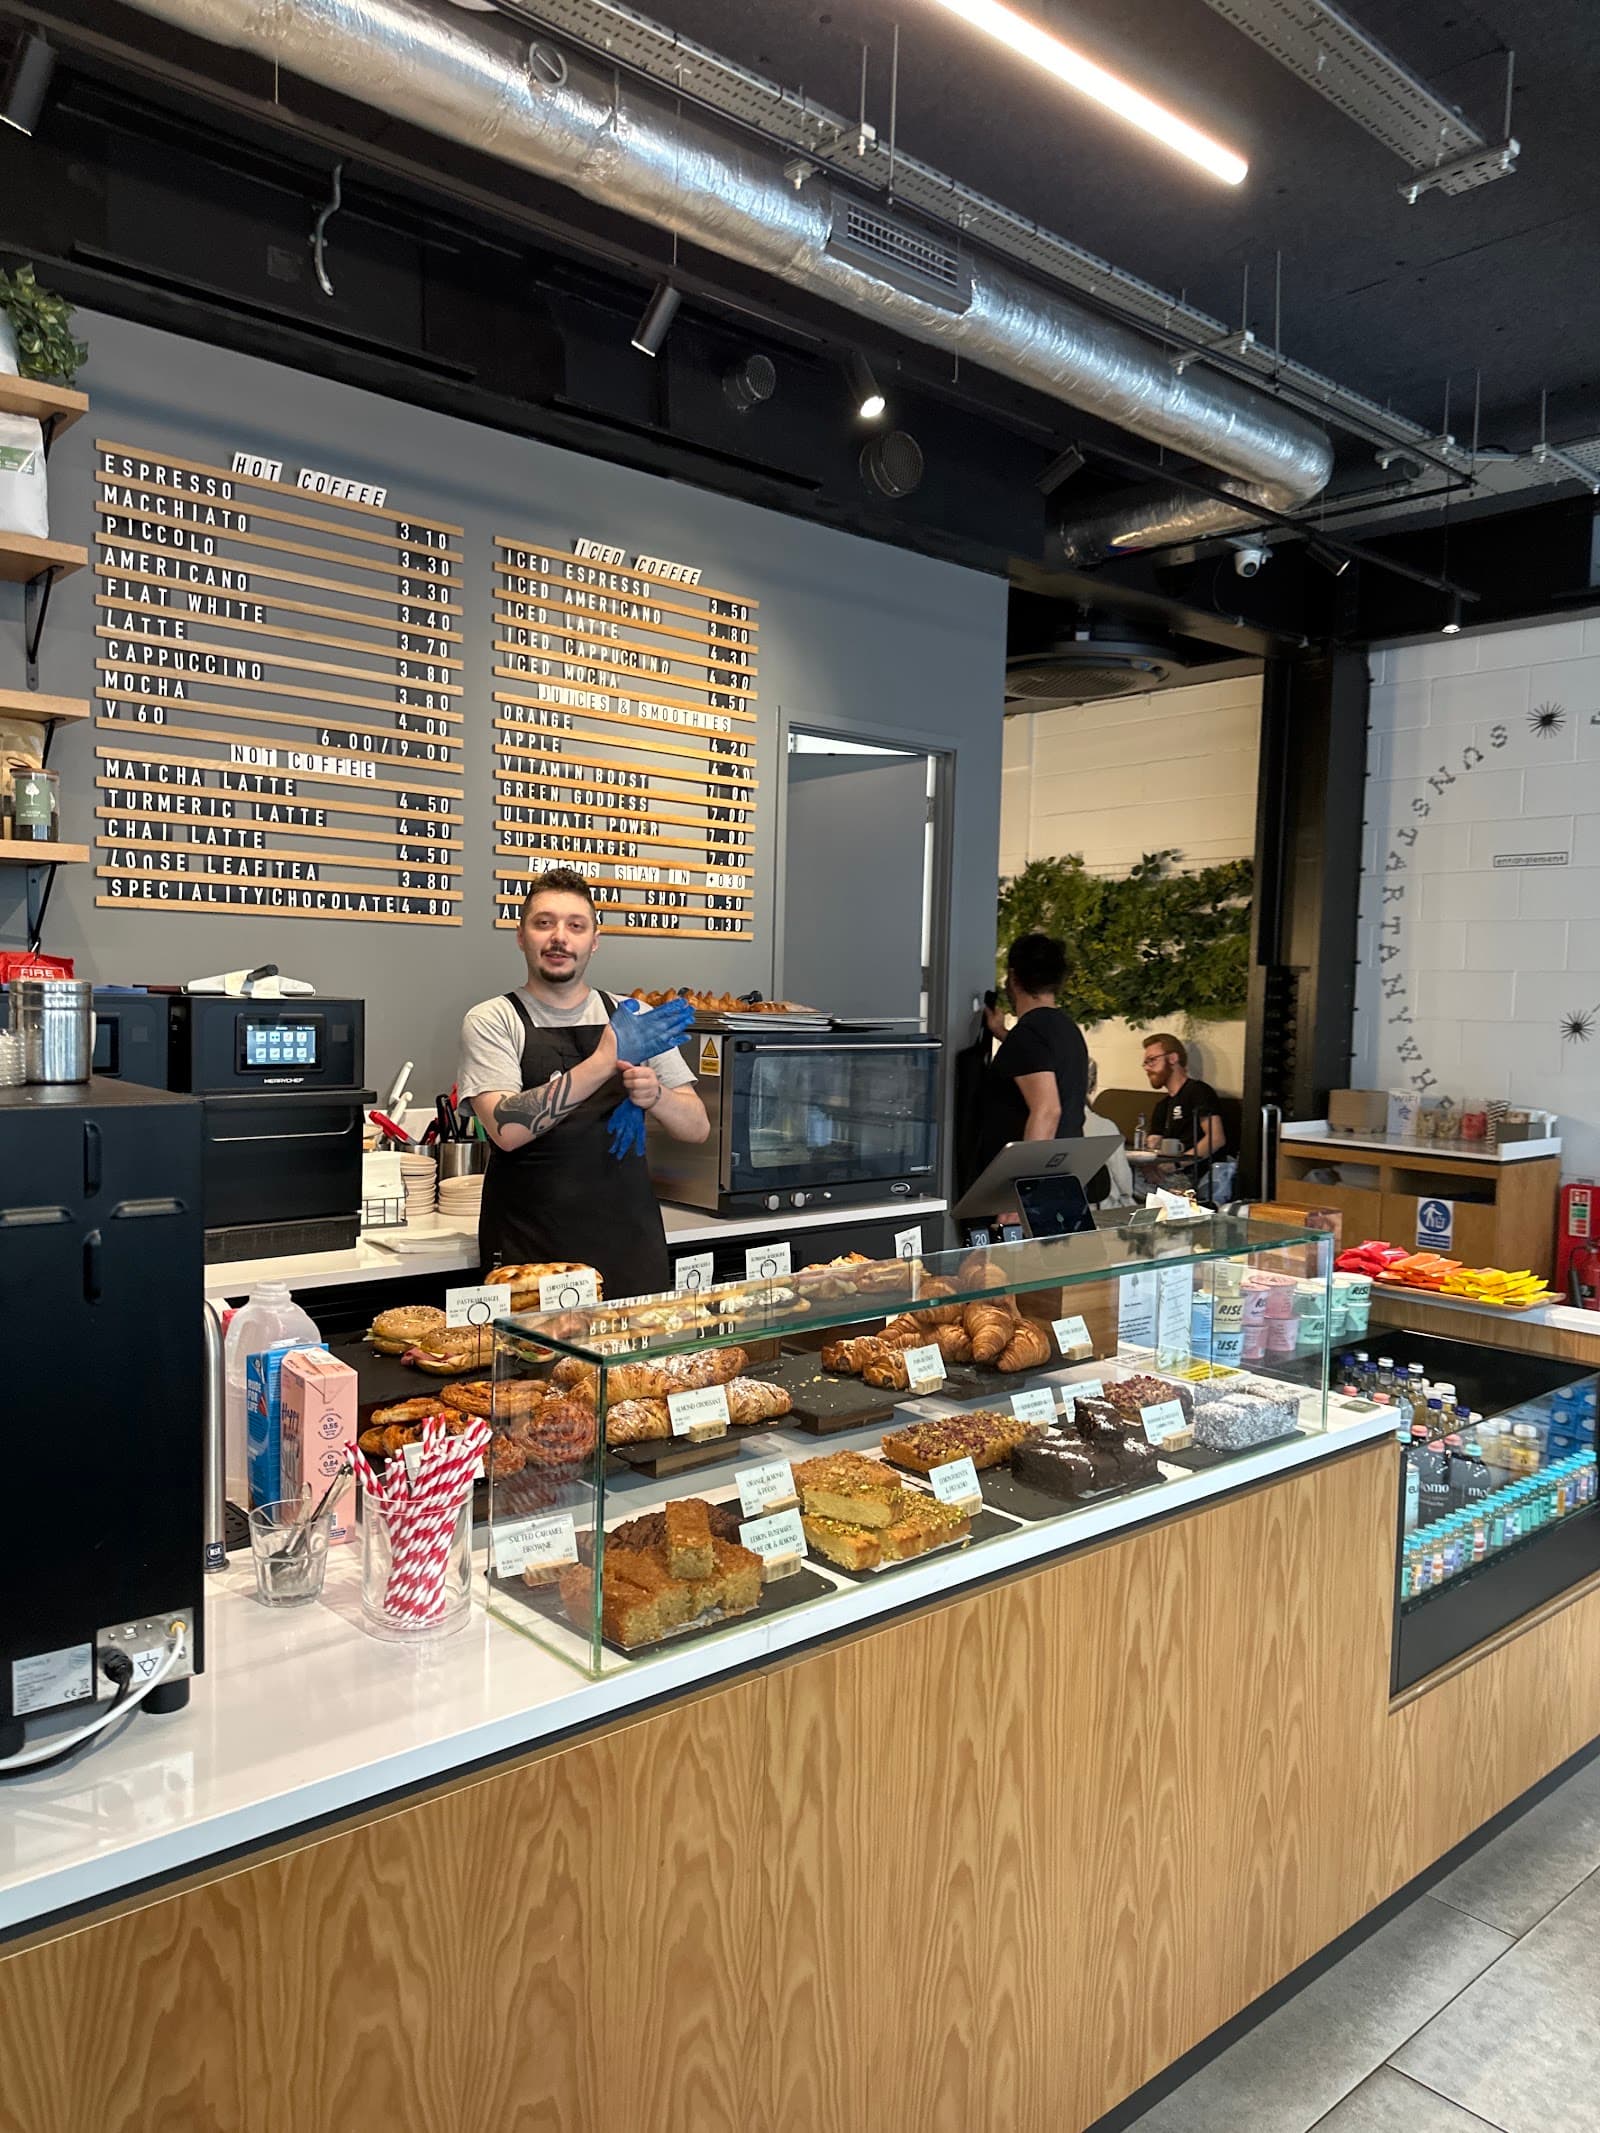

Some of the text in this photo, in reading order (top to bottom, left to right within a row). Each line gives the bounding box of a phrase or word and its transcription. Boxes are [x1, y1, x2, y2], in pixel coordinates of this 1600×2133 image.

[105, 454, 446, 549] ESPRESSO 3.10
[236, 457, 384, 507] HOT COFFEE
[104, 484, 449, 576] MACCHIATO 3.30
[106, 516, 449, 604] PICCOLO 3.30
[579, 540, 699, 585] ICED COFFEE
[104, 548, 450, 631] AMERICANO 3.40
[507, 549, 747, 620] ICED ESPRESSO 3.50
[108, 578, 447, 657] FLAT WHITE 3.70
[507, 576, 748, 644] ICED AMERICANO 3.80
[107, 609, 448, 684] LATTE 3.80
[507, 601, 747, 666] ICED LATTE 4.30
[108, 641, 448, 711] CAPPUCCINO 3.80
[507, 627, 749, 690] ICED CAPPUCCINO 430
[104, 670, 447, 736] MOCHA 4.00
[508, 652, 745, 712] ICED MOCHA 4.50
[105, 700, 117, 719] V
[137, 704, 164, 724] 60
[504, 703, 747, 757] ORANGE 4.20
[541, 685, 729, 732] JUICES & SMOOTHIES
[234, 747, 373, 778] NOT COFFEE
[503, 730, 560, 752] APPLE
[106, 758, 448, 814] MATCHA LATTE 4.50
[503, 755, 583, 780] VITAMIN
[595, 771, 649, 789] BOOST
[108, 789, 448, 840] TURMERIC LATTE 4.50
[503, 781, 745, 823] GREEN GODDESS 7.00
[108, 819, 448, 865] CHAI LATTE 4.50
[504, 806, 744, 845] ULTIMATE POWER 7.00
[110, 849, 448, 891] LOOSE LEAF TEA 3.80
[504, 831, 744, 867] SUPERCHARGER 7.00
[618, 866, 657, 882] STAY
[672, 870, 687, 884] IN
[402, 899, 449, 916] 4.80
[627, 912, 742, 932] SYRUP 0.30
[648, 889, 687, 907] SHOT
[707, 893, 743, 910] 0.50
[21, 968, 54, 977] FIRE
[975, 1233, 987, 1246] 20
[1351, 1286, 1368, 1295] RIS
[1421, 1483, 1450, 1494] omo
